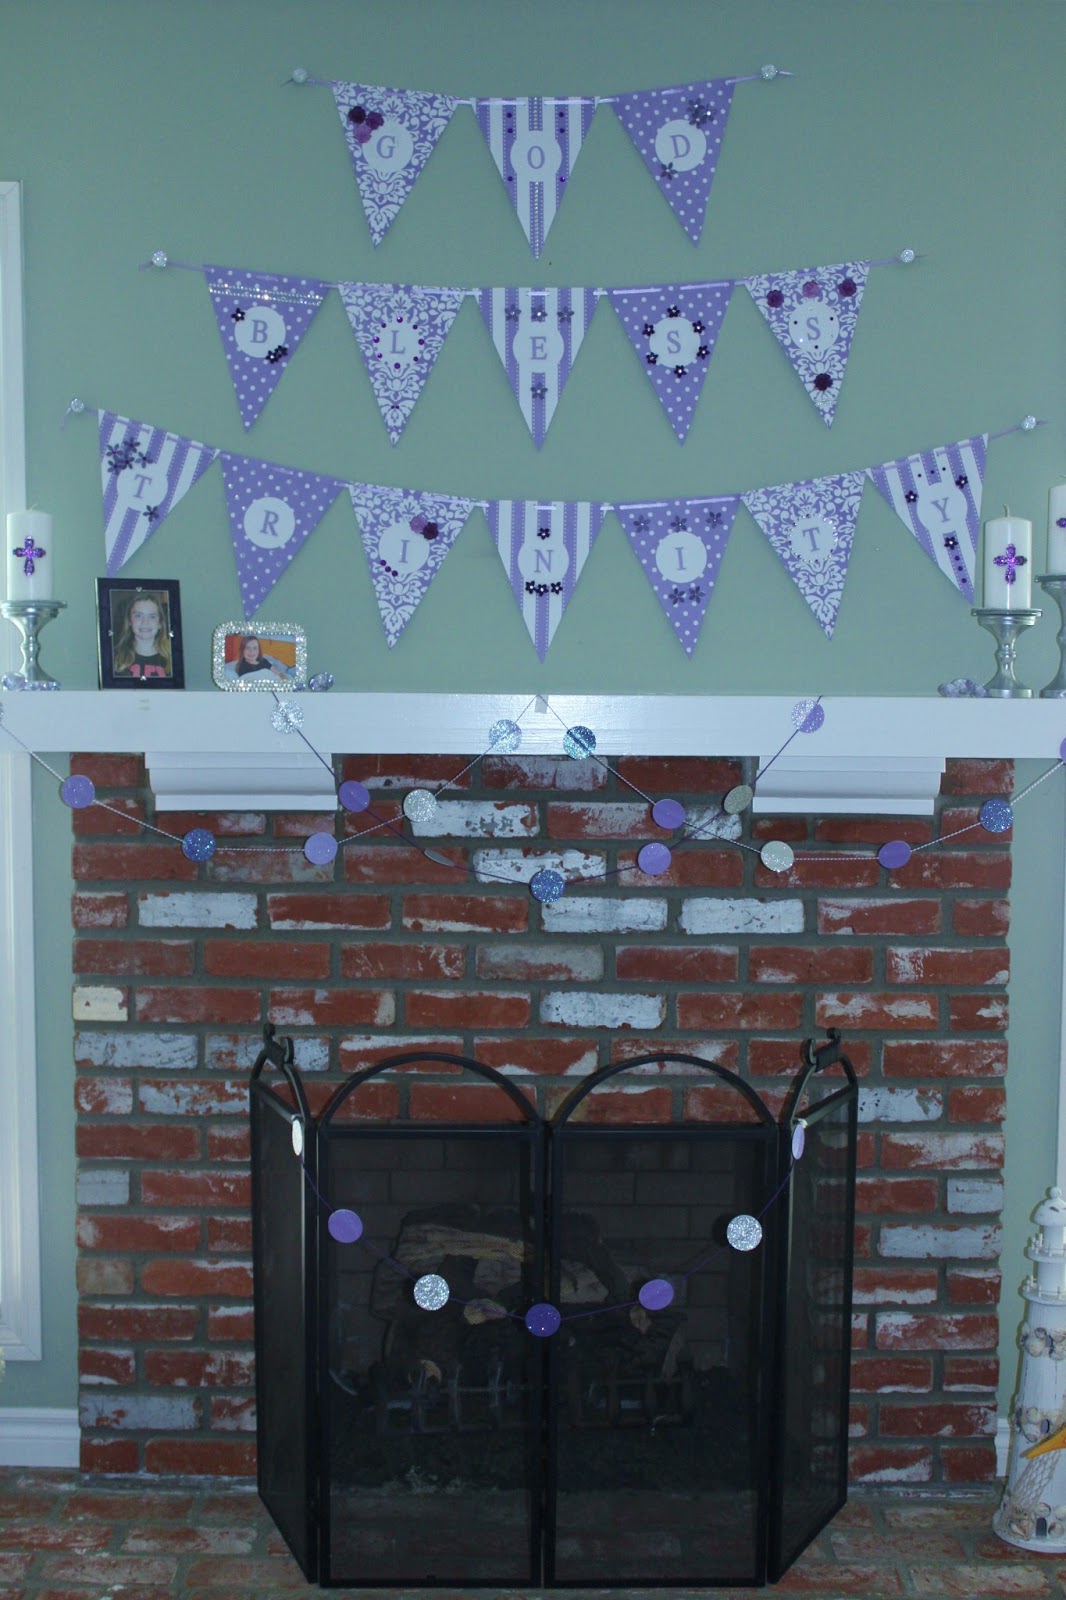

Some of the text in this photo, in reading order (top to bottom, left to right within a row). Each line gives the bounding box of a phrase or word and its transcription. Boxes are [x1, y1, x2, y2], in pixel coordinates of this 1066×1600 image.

[375, 133, 691, 170] G O D
[249, 316, 822, 361] B L E S S
[132, 473, 952, 574] T R I N I T Y
